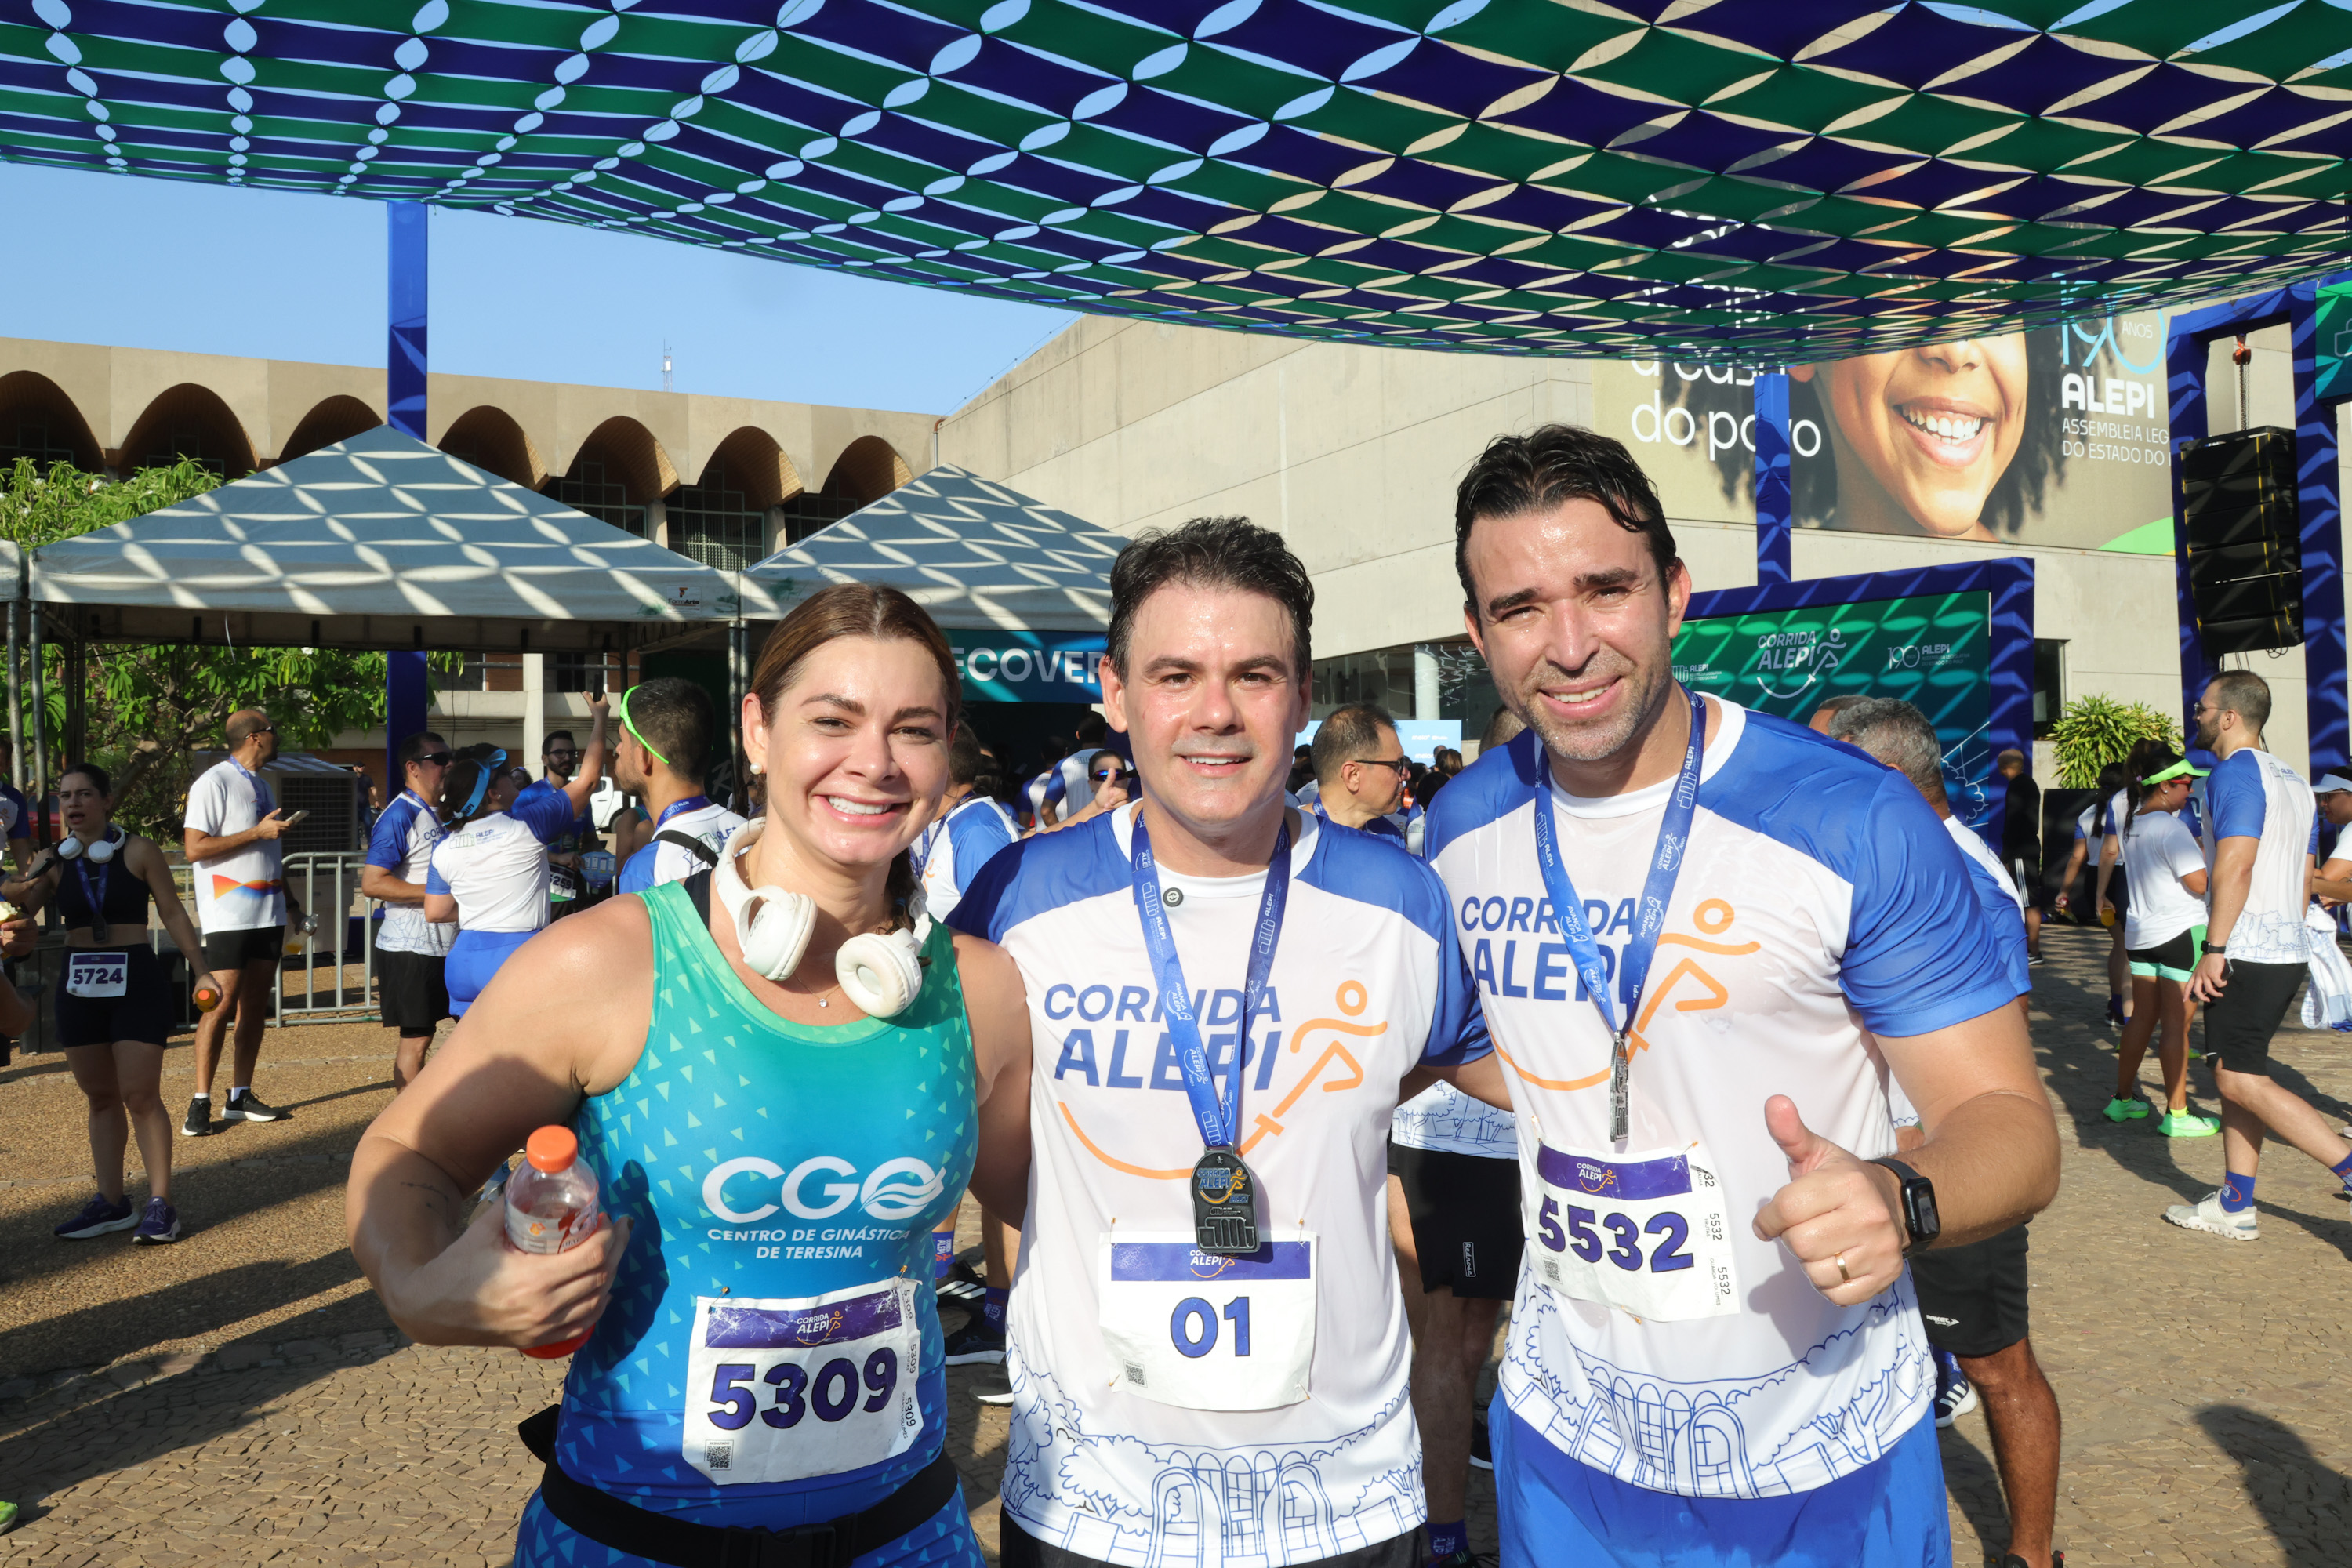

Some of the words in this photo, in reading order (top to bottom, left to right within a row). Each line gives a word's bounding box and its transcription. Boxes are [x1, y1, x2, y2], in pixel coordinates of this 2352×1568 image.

[2122, 321, 2153, 339] ANOS
[2061, 373, 2154, 419] ALEPI
[1631, 389, 1695, 445] do
[2062, 417, 2143, 441] ASSEMBLEIA
[2063, 440, 2085, 457] DO
[2089, 443, 2142, 463] ESTADO
[2145, 448, 2165, 466] DO
[1757, 630, 1817, 649] CORRIDA
[1922, 644, 1951, 655] ALEPI
[1690, 663, 1709, 672] ALEPI
[1757, 645, 1816, 670] ALEPI
[1684, 746, 1695, 770] ALEPI
[1544, 844, 1554, 867] ALEPI
[1657, 844, 1668, 870] CORRIDA
[1662, 844, 1674, 871] ALEPI
[1264, 892, 1274, 916] ALEPI
[1461, 895, 1636, 936] CORRDA
[1156, 916, 1167, 940] ALEPI
[1564, 916, 1576, 935] ALEPI
[1648, 908, 1658, 931] ALEPI
[73, 967, 125, 985] 5724
[1171, 992, 1181, 1011] ALEPI
[1189, 1048, 1202, 1073] ALEPI
[1196, 1047, 1207, 1072] CORRIDA
[1197, 1168, 1230, 1177] CORRIDA
[1577, 1163, 1602, 1174] CORRIDA
[1578, 1169, 1602, 1182] ALEPI
[1199, 1177, 1230, 1189] ALEPI
[707, 1229, 786, 1242] CENTRO
[791, 1229, 817, 1241] DE
[820, 1225, 911, 1241] GINÁSTICA
[1538, 1192, 1695, 1273] 5532
[1710, 1212, 1723, 1241] 5532
[755, 1246, 781, 1259] DE
[785, 1245, 863, 1259] TERESINA
[1190, 1256, 1222, 1266] ALEPI
[1717, 1266, 1731, 1296] 5532
[903, 1289, 913, 1319] 5309
[796, 1320, 830, 1334] ALEPI
[797, 1313, 829, 1325] CORRIDA
[1170, 1295, 1251, 1359] 01
[706, 1346, 898, 1431] 5309
[904, 1396, 916, 1427] 5309
